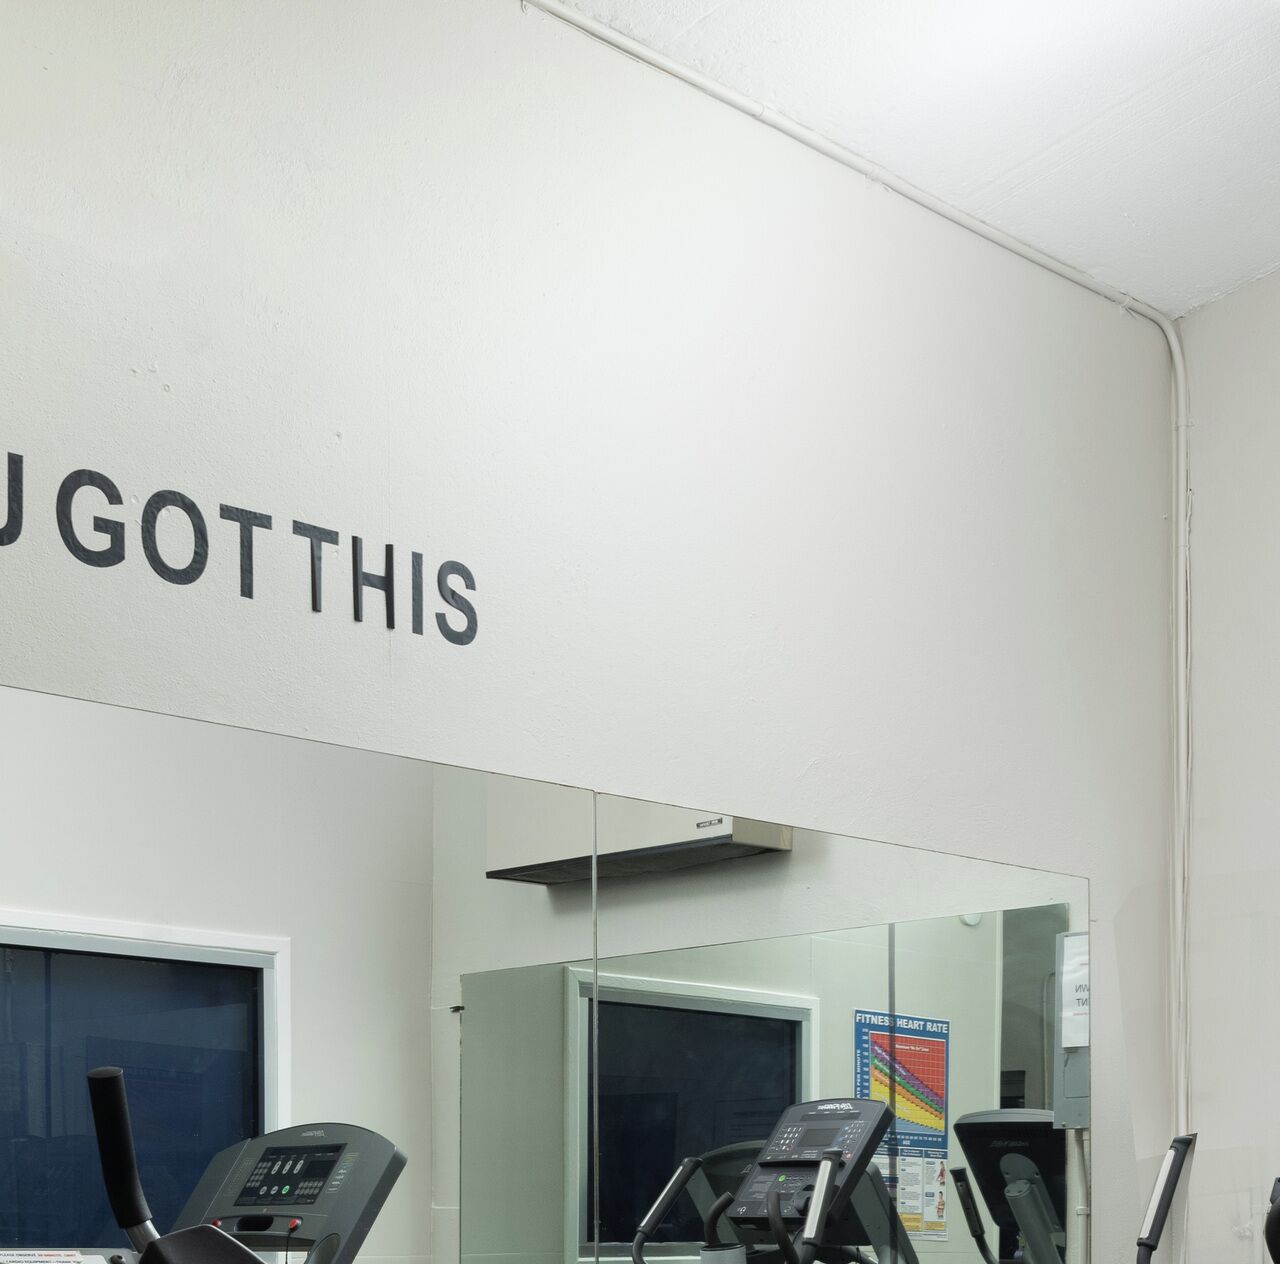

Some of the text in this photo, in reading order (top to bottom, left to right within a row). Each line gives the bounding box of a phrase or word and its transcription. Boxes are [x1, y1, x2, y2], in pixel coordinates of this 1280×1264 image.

[56, 468, 272, 599] GOT
[292, 519, 478, 646] THIS
[897, 1018, 924, 1030] HEART
[926, 1022, 948, 1033] RATE
